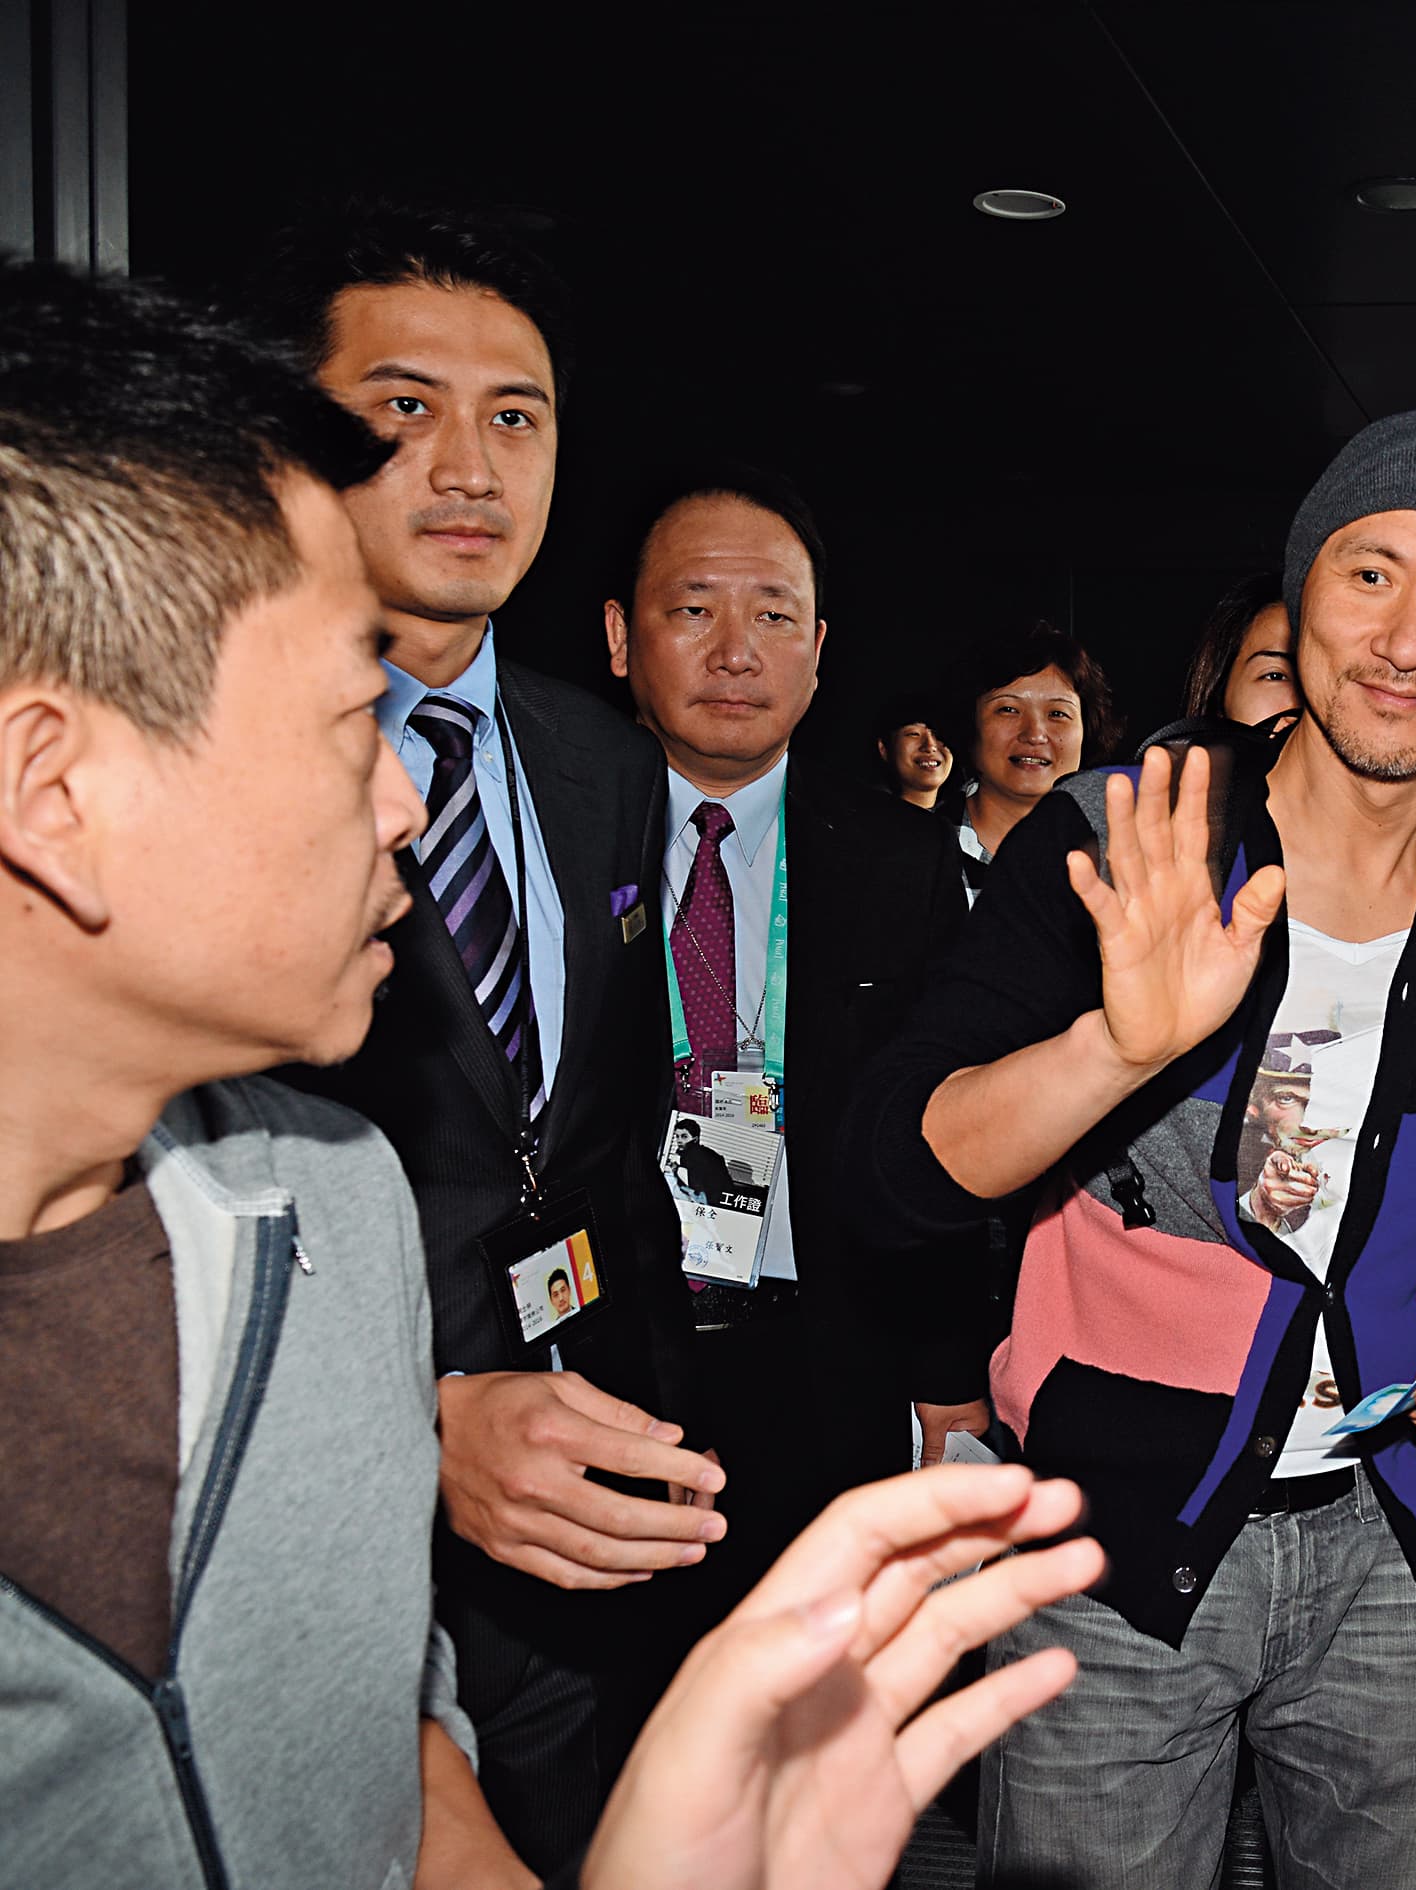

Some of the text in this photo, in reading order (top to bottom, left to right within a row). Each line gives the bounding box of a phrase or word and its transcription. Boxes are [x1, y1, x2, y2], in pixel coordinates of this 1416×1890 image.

[719, 1191, 762, 1213] 工作證
[583, 1262, 593, 1282] 4
